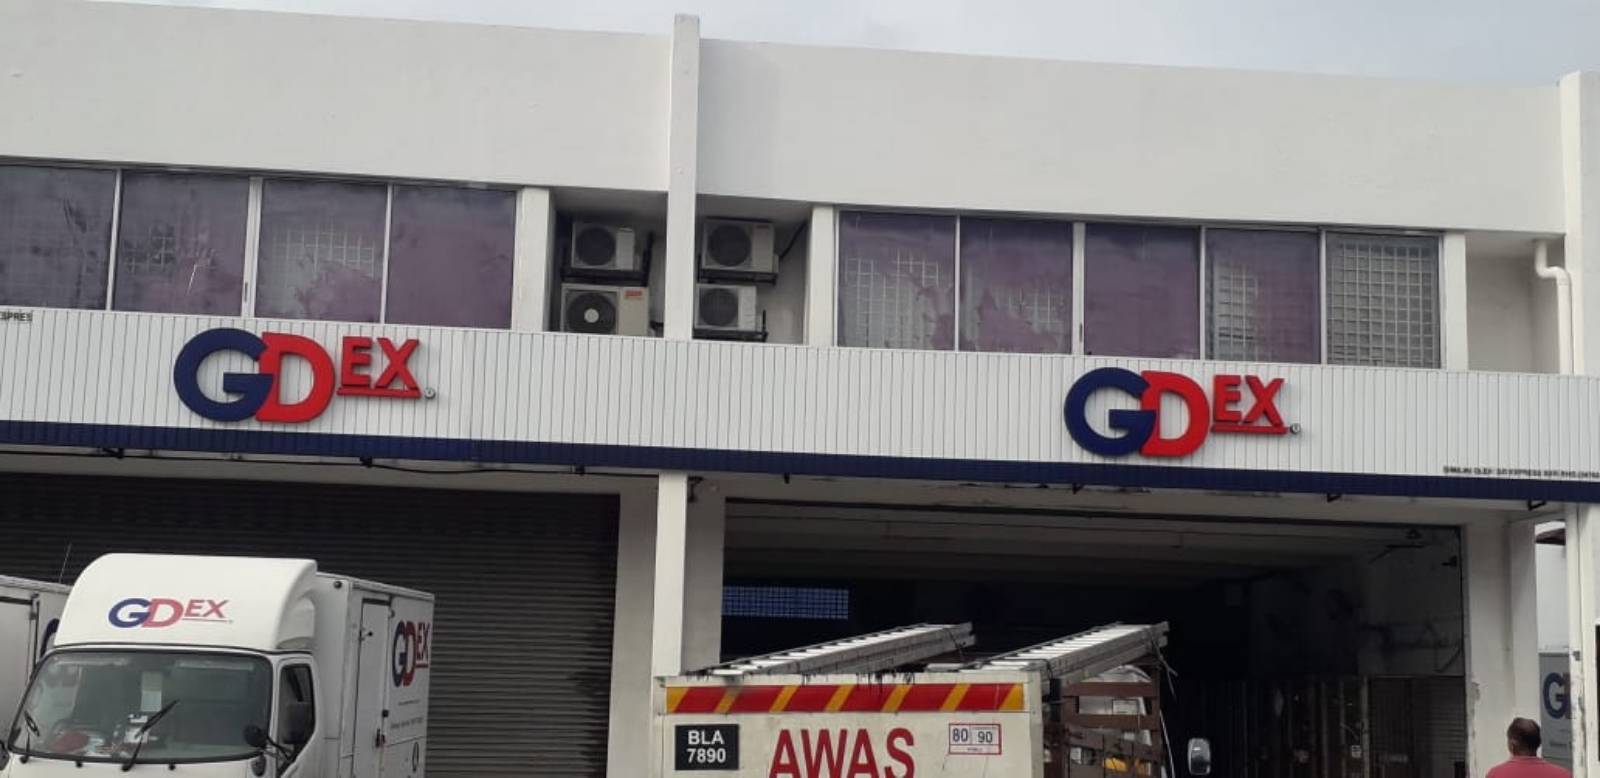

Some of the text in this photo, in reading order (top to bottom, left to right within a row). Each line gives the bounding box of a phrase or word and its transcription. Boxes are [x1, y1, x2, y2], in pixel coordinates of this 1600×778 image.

[687, 730, 724, 745] BLA
[952, 728, 968, 742] 80
[977, 731, 993, 743] 90
[687, 748, 726, 764] 7890
[768, 727, 915, 778] AWAS
